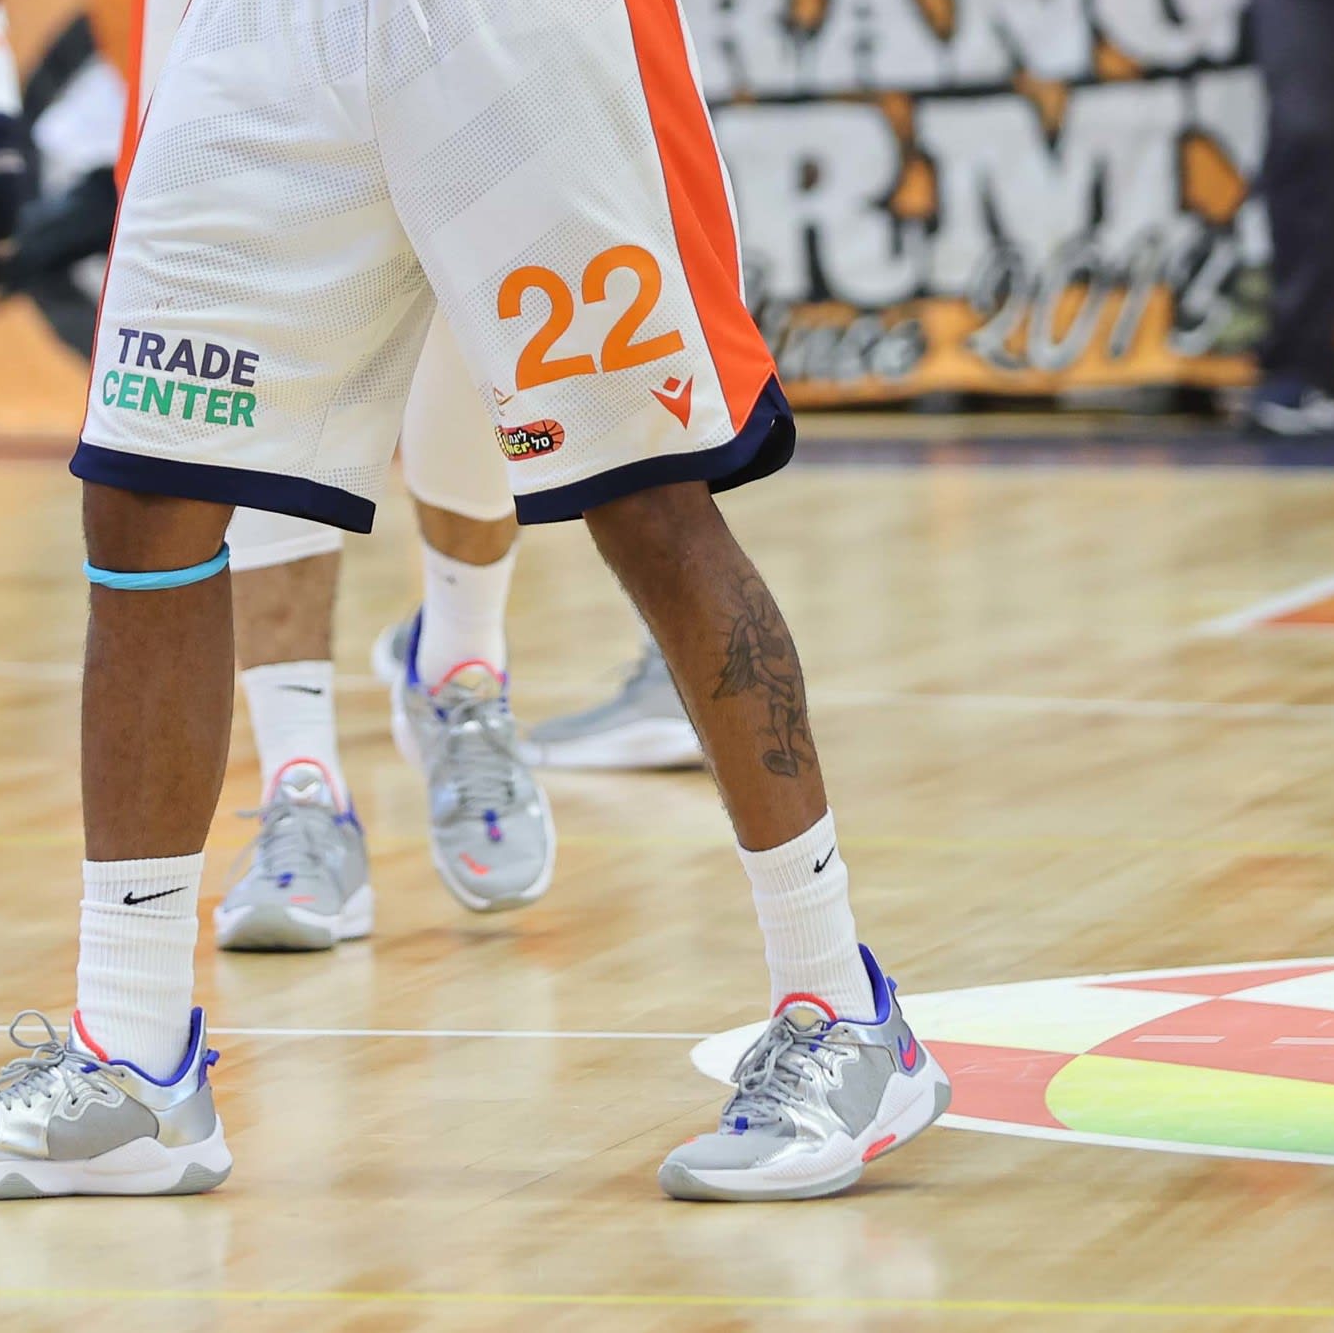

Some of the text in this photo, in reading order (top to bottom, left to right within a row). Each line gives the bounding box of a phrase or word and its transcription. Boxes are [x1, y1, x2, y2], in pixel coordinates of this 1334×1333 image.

[497, 245, 685, 390] 22
[119, 328, 259, 387] TRADE
[102, 370, 257, 427] CENTER
[531, 436, 550, 450] סל
